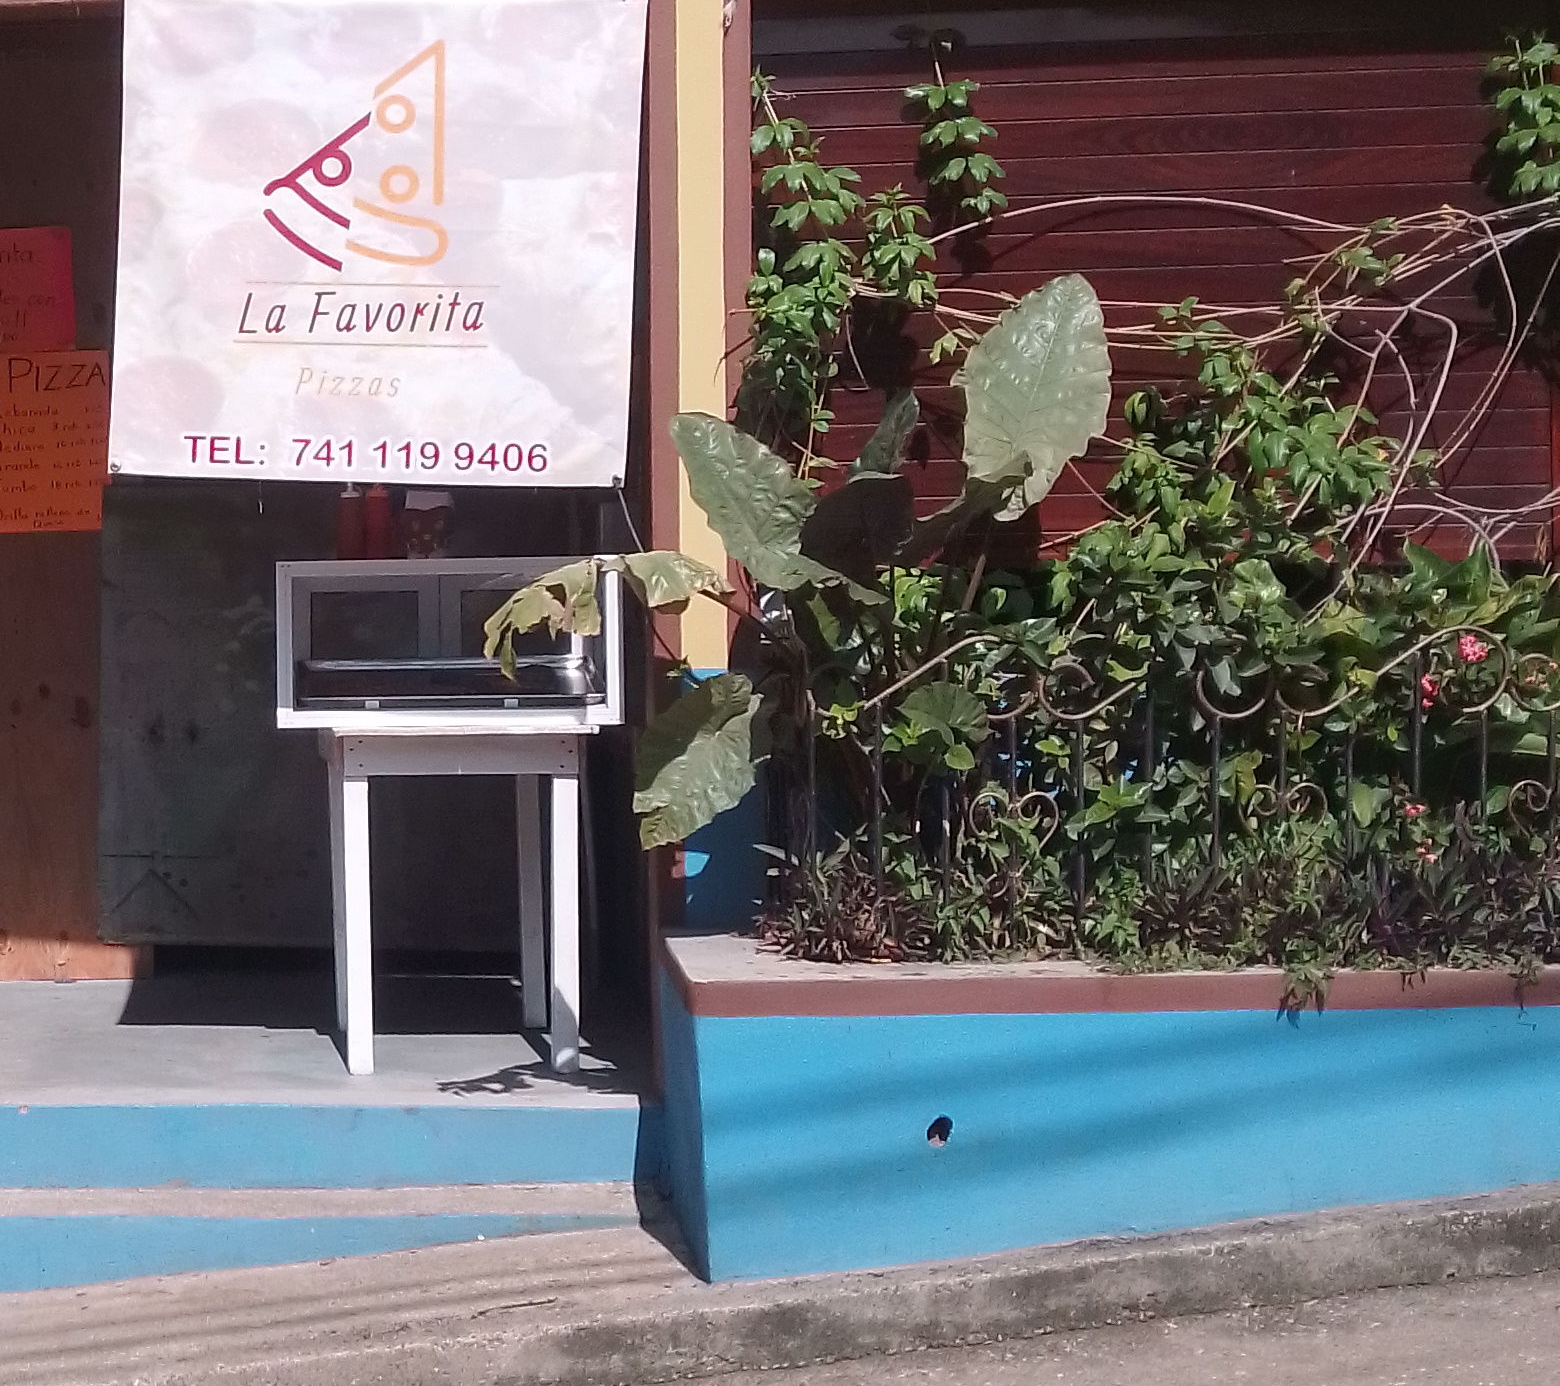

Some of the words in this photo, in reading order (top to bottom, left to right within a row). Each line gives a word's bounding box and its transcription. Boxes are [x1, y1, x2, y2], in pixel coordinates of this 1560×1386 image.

[237, 292, 287, 334] La
[308, 291, 485, 334] Favorita
[7, 357, 106, 393] PIZZA
[294, 366, 402, 398] Pizzas
[184, 435, 268, 467] TEL:
[291, 438, 355, 468] 741
[371, 440, 441, 470] 119
[453, 441, 550, 473] 9406
